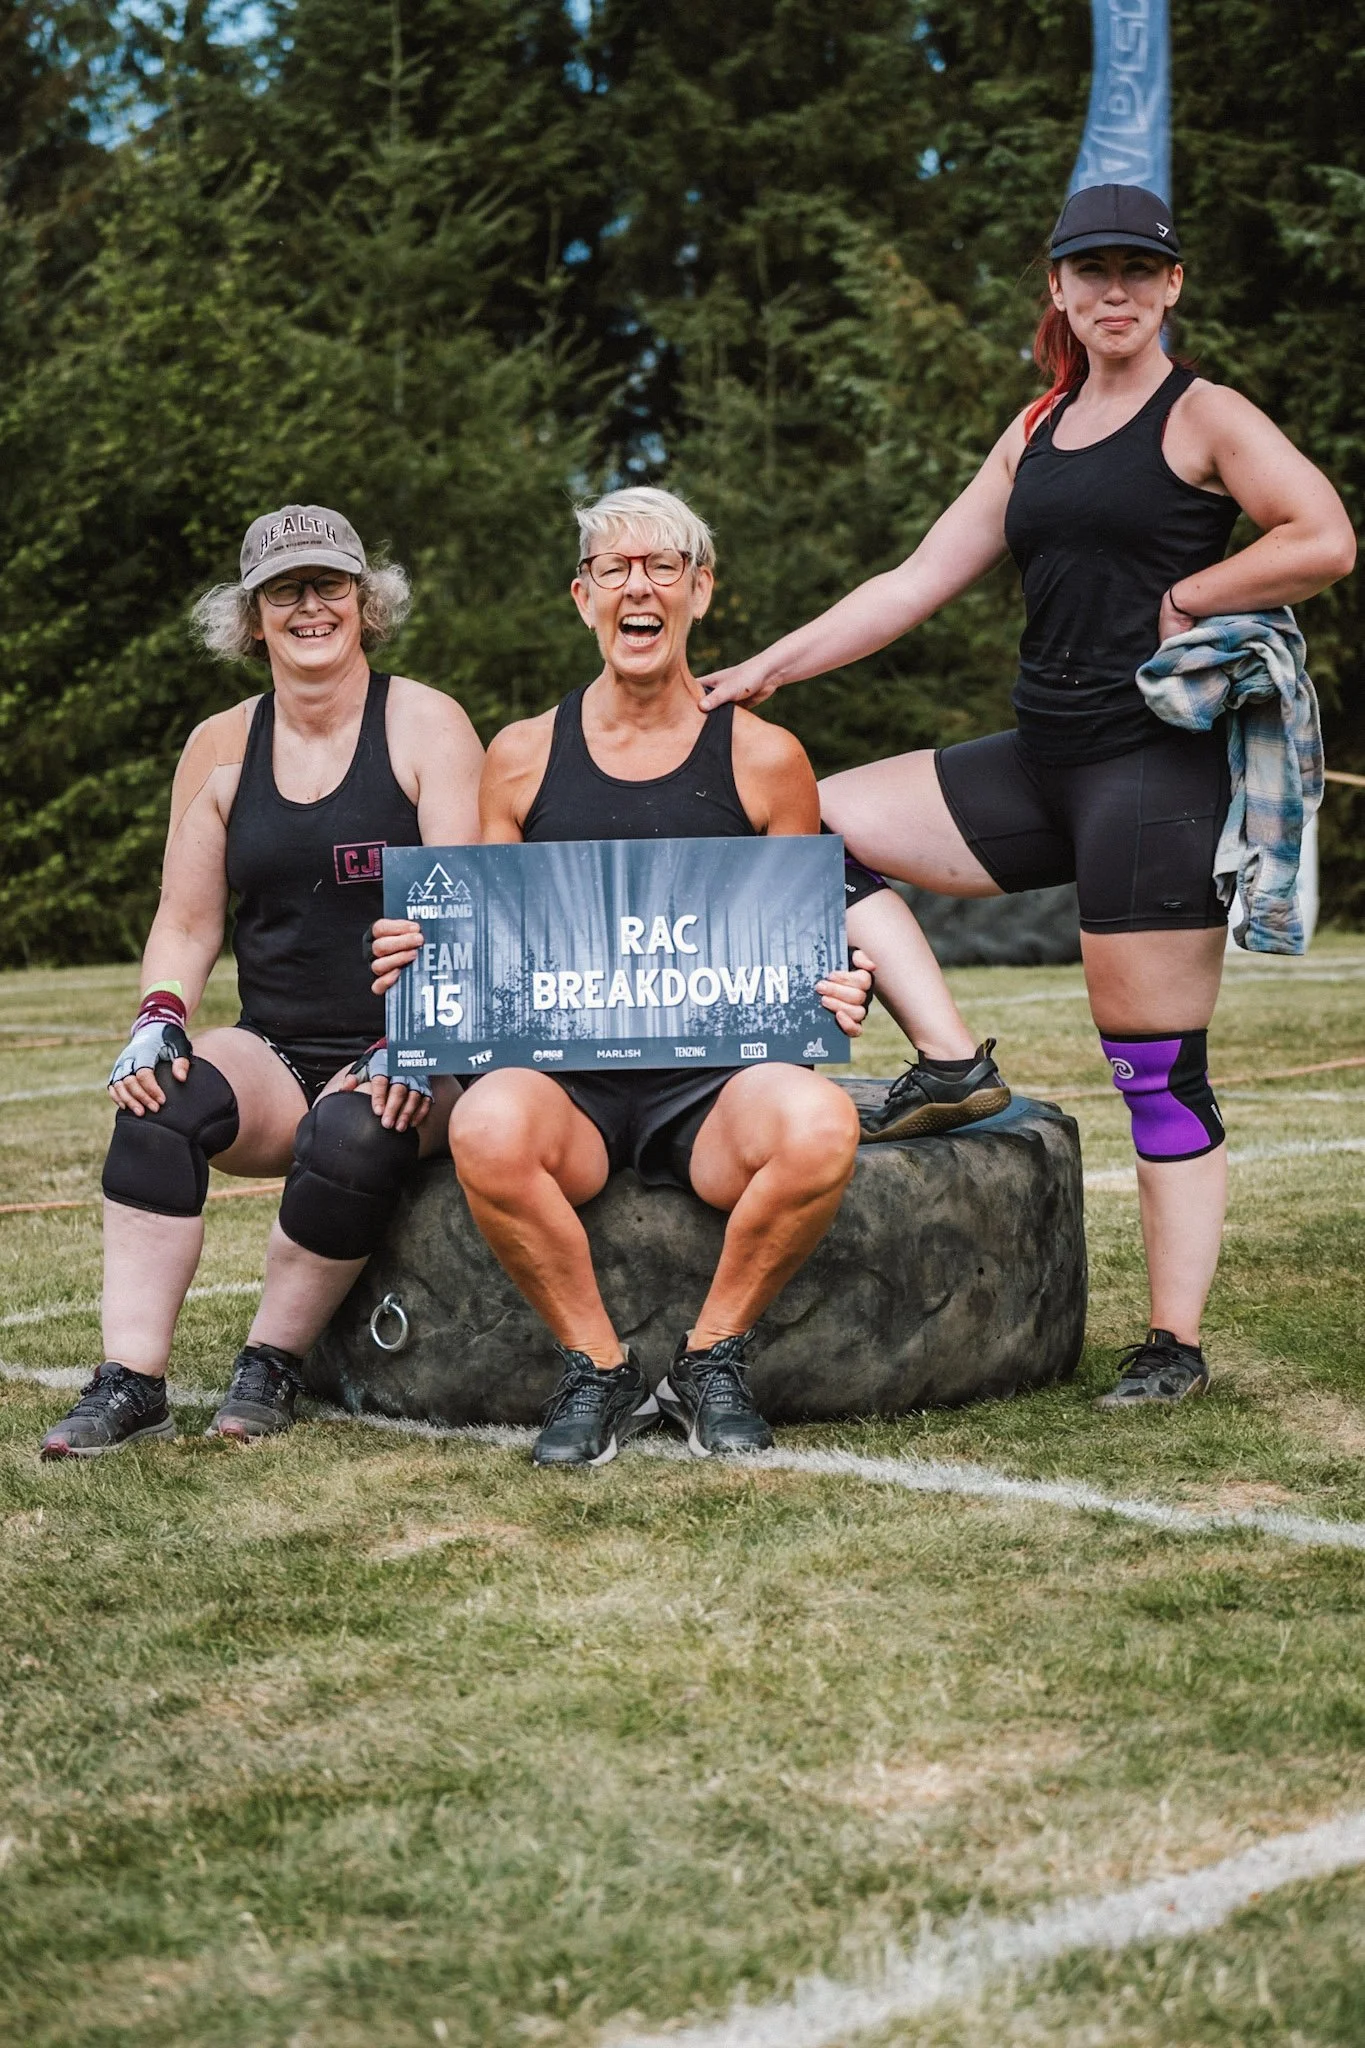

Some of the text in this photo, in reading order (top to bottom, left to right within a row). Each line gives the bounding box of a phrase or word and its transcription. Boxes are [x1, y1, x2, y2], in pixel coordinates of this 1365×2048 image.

[260, 514, 338, 559] HEALTH
[406, 904, 473, 920] WODLAND
[620, 914, 699, 955] RAC
[532, 965, 790, 1011] BREAKDOWN
[421, 984, 463, 1028] 15
[397, 1050, 426, 1059] PROUDLY
[468, 1051, 493, 1066] TKF
[596, 1049, 641, 1059] MARLISH
[674, 1046, 706, 1057] TENZING
[397, 1058, 437, 1067] POWERED BY
